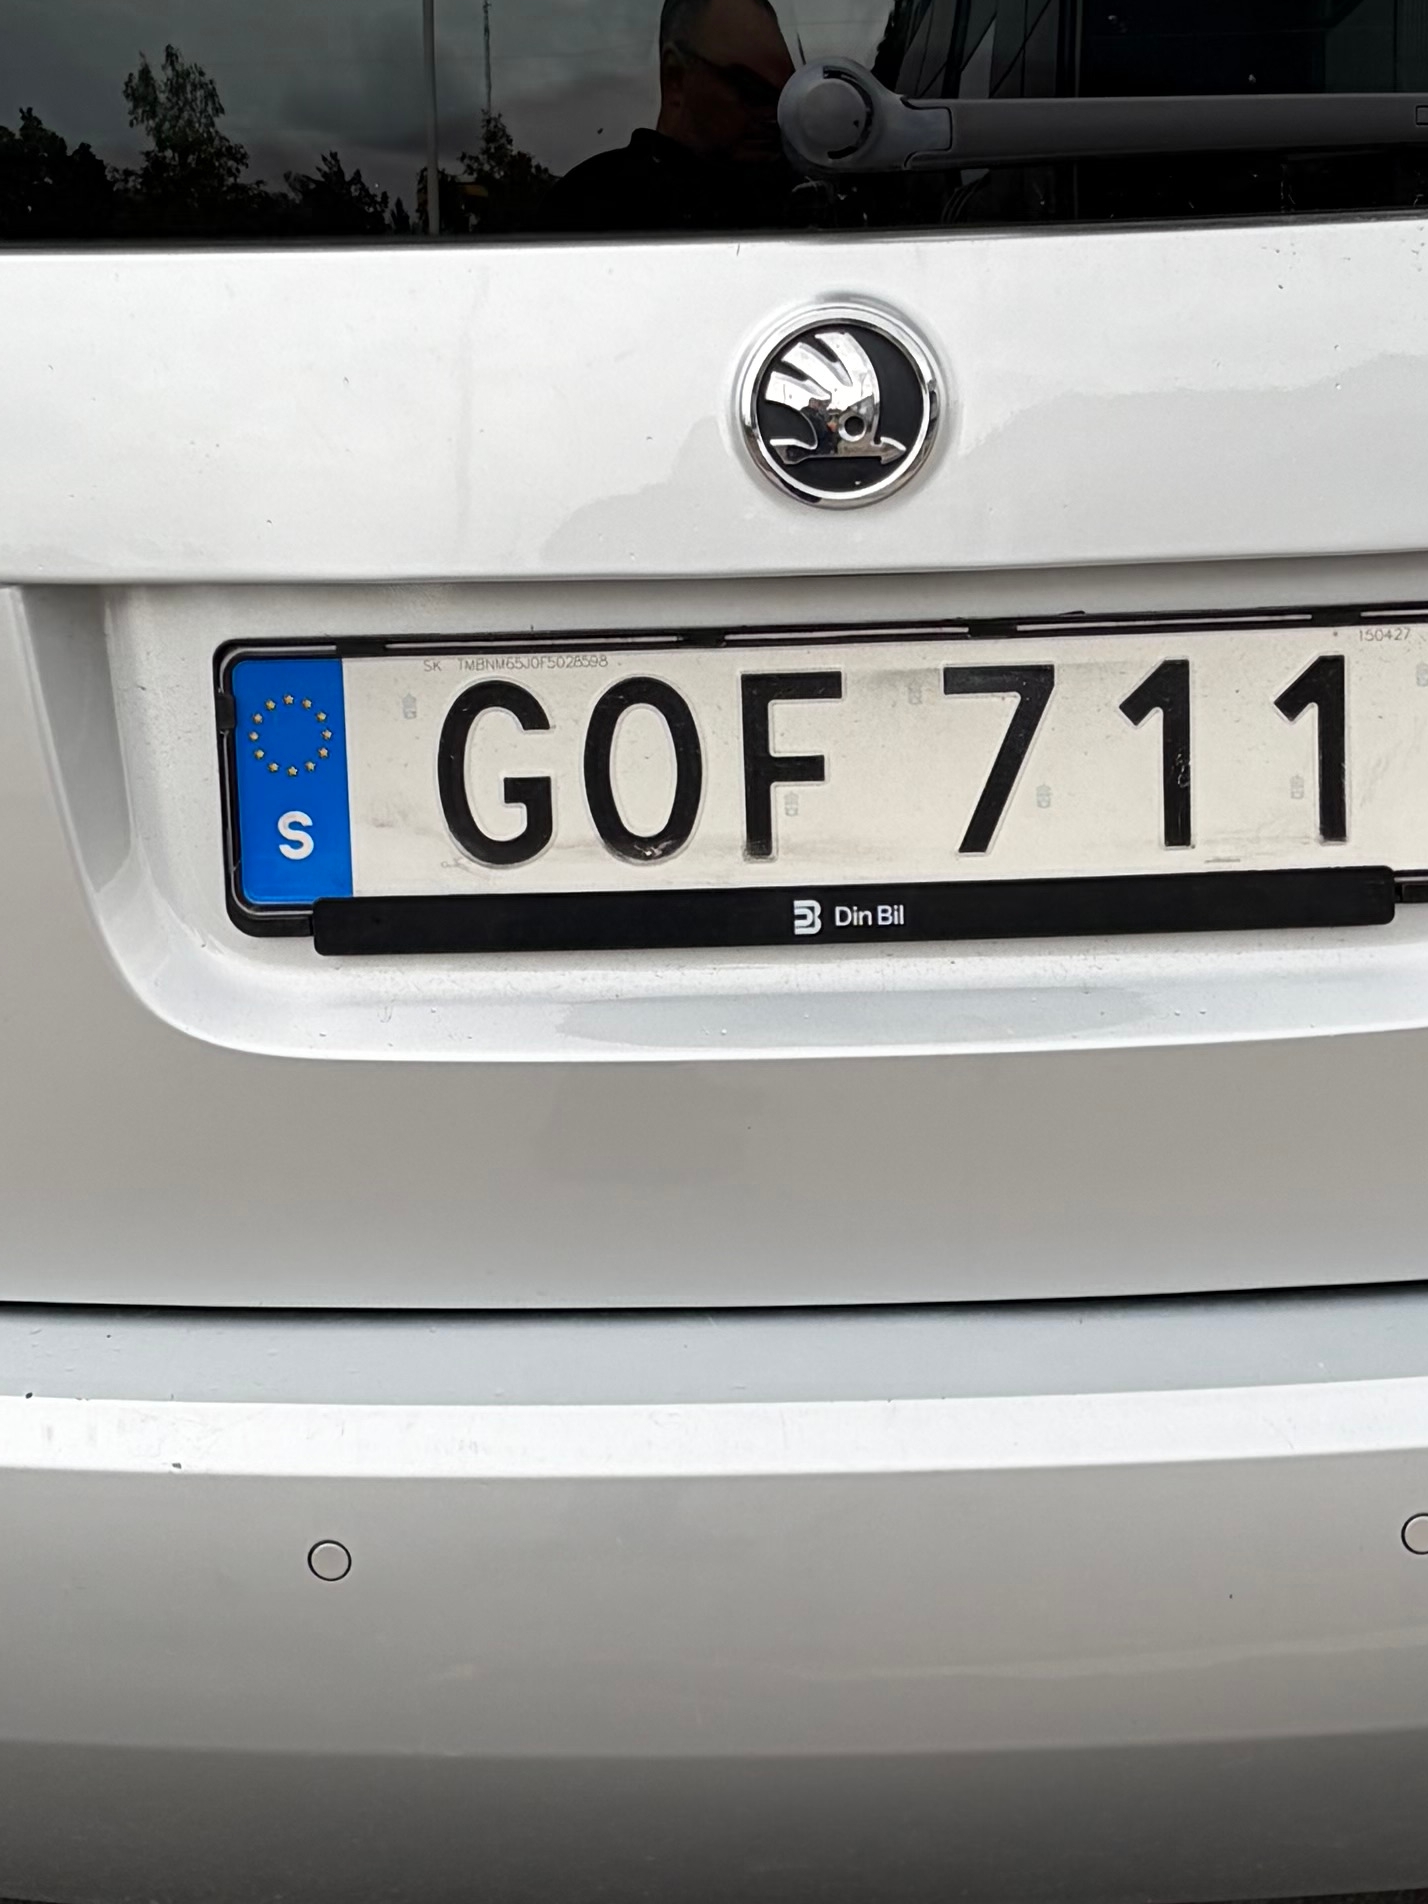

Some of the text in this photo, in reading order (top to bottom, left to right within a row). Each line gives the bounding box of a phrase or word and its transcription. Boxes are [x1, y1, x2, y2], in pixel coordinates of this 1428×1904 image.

[1358, 627, 1411, 642] 150427
[423, 659, 442, 672] SK
[437, 654, 1348, 865] GOF 711
[277, 810, 315, 860] S
[834, 904, 905, 927] Din Bil
